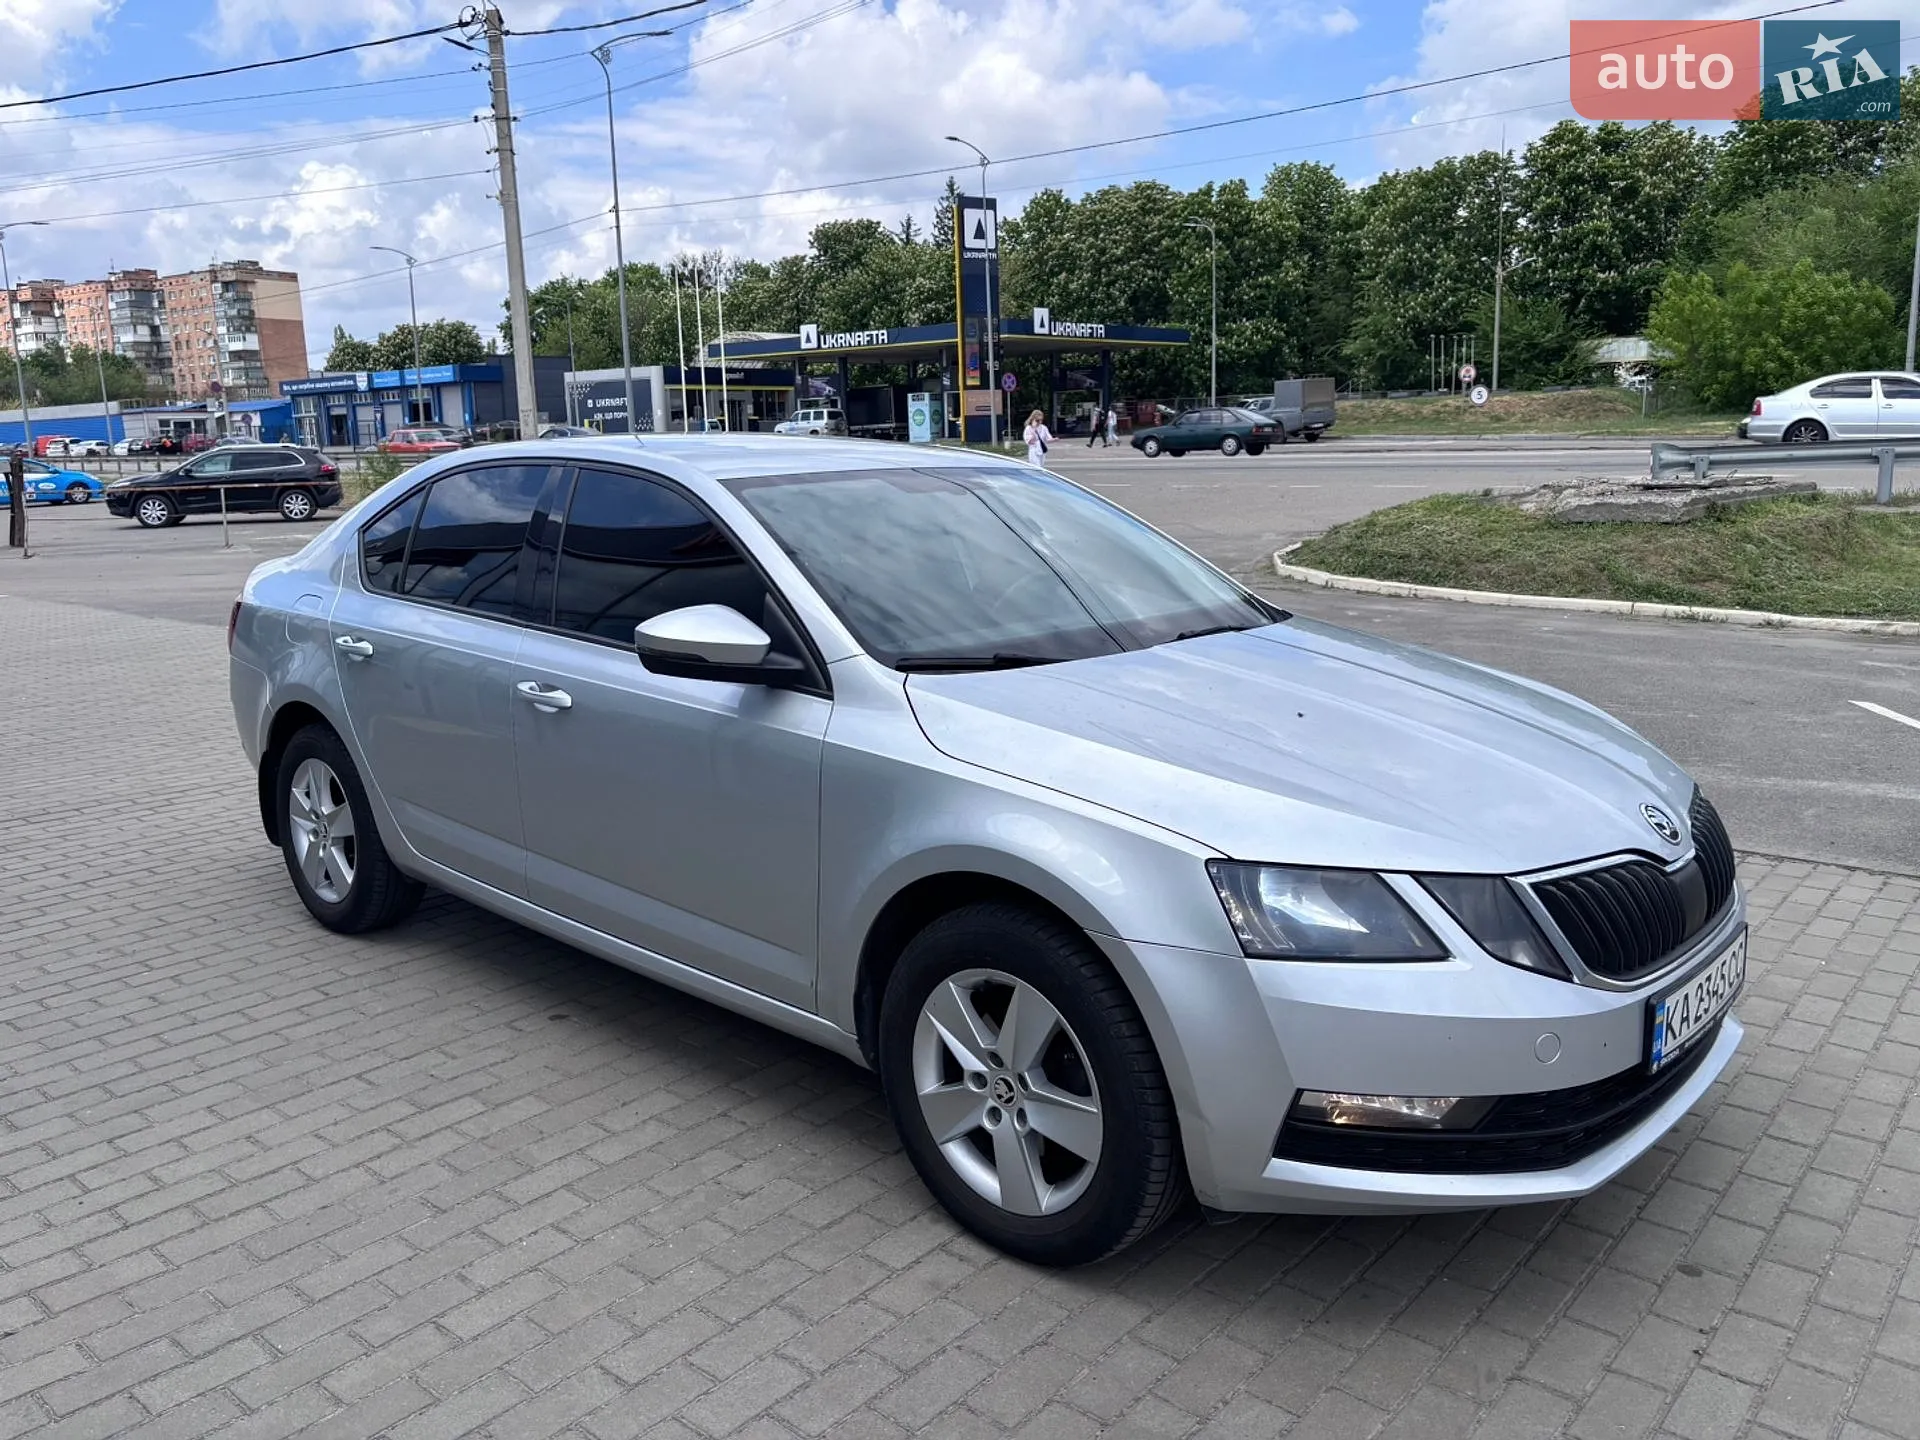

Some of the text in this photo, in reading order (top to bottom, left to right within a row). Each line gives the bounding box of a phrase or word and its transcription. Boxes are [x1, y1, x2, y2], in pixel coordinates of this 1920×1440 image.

[820, 329, 888, 349] UKRNAFTA
[1051, 320, 1105, 339] UKRNAFTA
[1476, 390, 1483, 400] 5
[1664, 992, 1691, 1048] KA
[1694, 960, 1727, 1025] 2345
